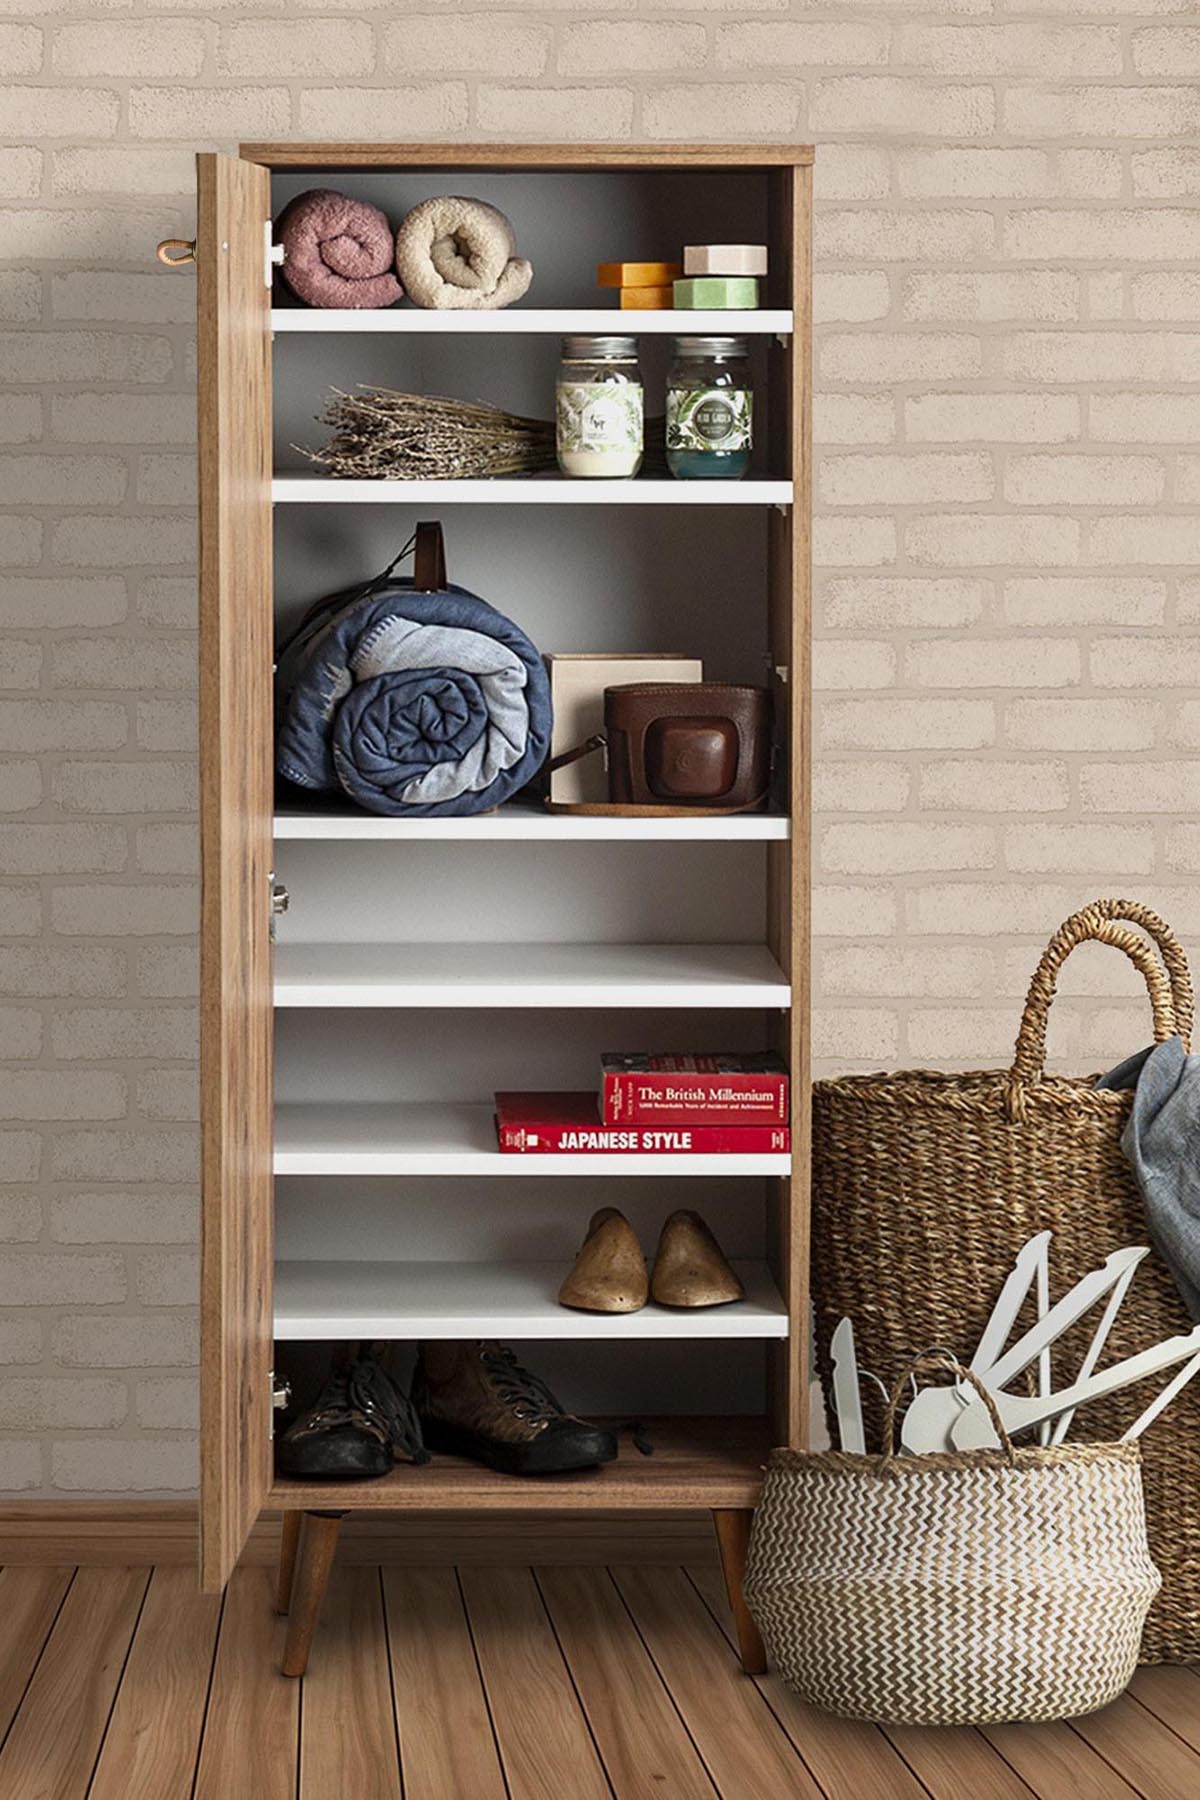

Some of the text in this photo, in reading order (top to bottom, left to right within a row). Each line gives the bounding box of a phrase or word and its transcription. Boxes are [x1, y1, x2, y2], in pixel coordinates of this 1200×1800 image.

[638, 1087, 774, 1101] The British Millennium
[558, 1132, 692, 1149] JAPANESE STYLE
